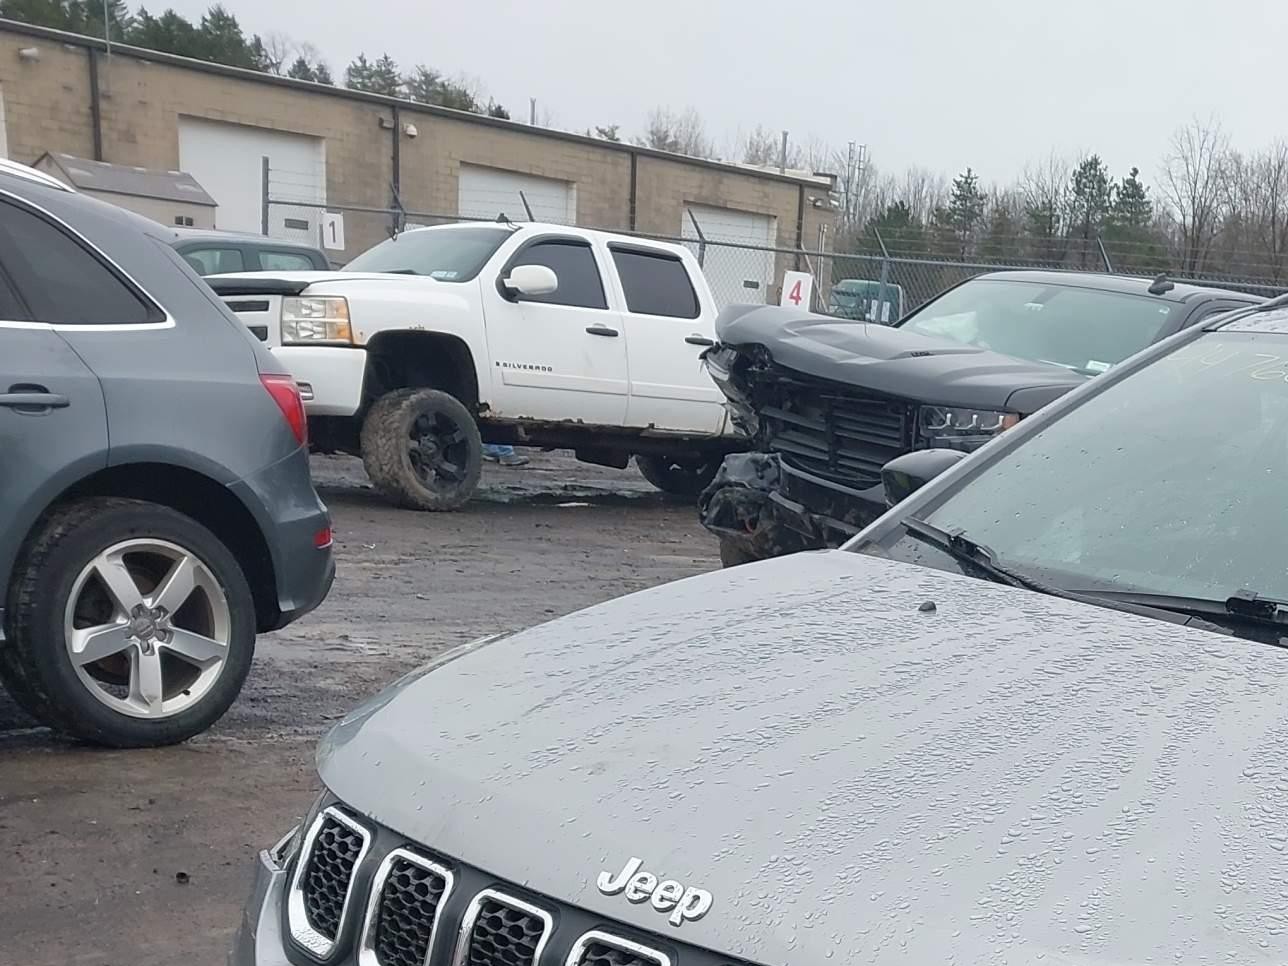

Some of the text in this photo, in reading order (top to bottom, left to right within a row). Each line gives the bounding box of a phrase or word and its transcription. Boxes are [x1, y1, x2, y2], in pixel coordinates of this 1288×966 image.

[328, 220, 337, 244] 1
[788, 279, 802, 306] 4
[502, 361, 554, 373] SILVERADO
[596, 856, 714, 927] Jeep
